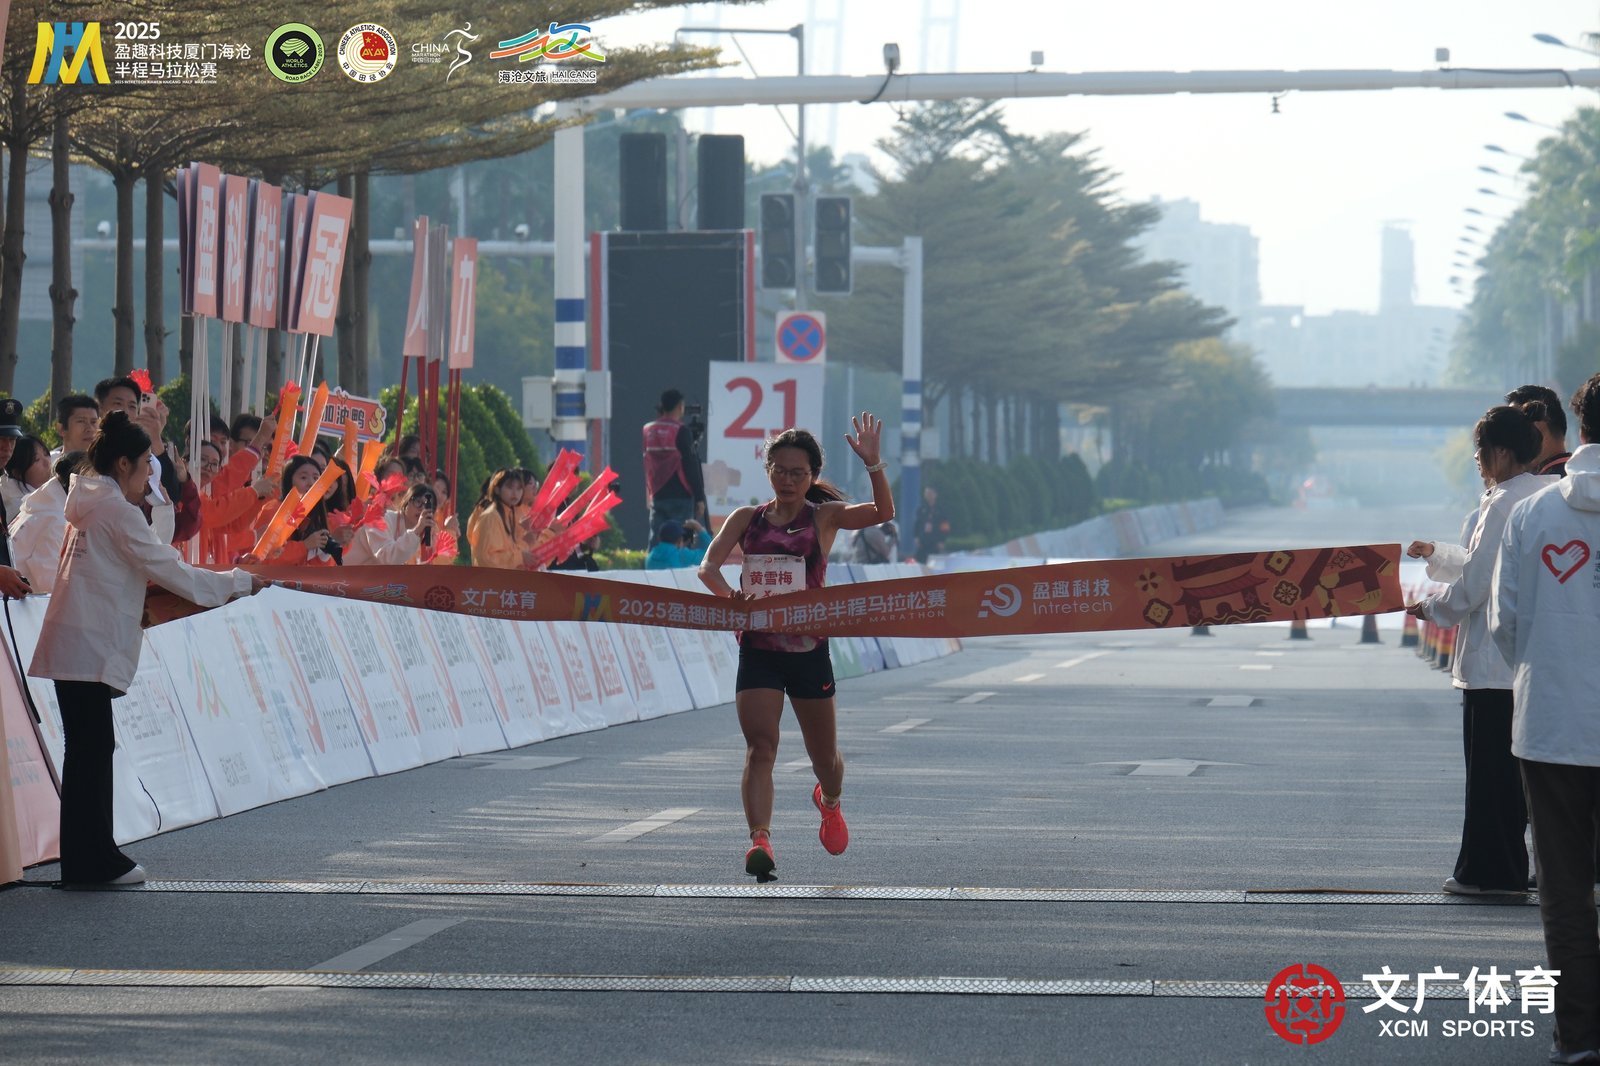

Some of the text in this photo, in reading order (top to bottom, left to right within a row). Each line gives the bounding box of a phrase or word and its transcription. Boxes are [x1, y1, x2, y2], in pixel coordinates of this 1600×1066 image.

[198, 185, 216, 296] 盈
[306, 214, 346, 319] 冠
[322, 403, 366, 430] 加油鸭
[723, 376, 798, 438] 21
[750, 571, 793, 586] 黄雪梅
[461, 588, 537, 610] 文广体育
[1032, 579, 1111, 600] 盈趣科技
[467, 607, 528, 617] XCM SPORTS
[1032, 599, 1113, 616] Intretech
[829, 618, 863, 628] HALF
[869, 610, 945, 624] MARATHON
